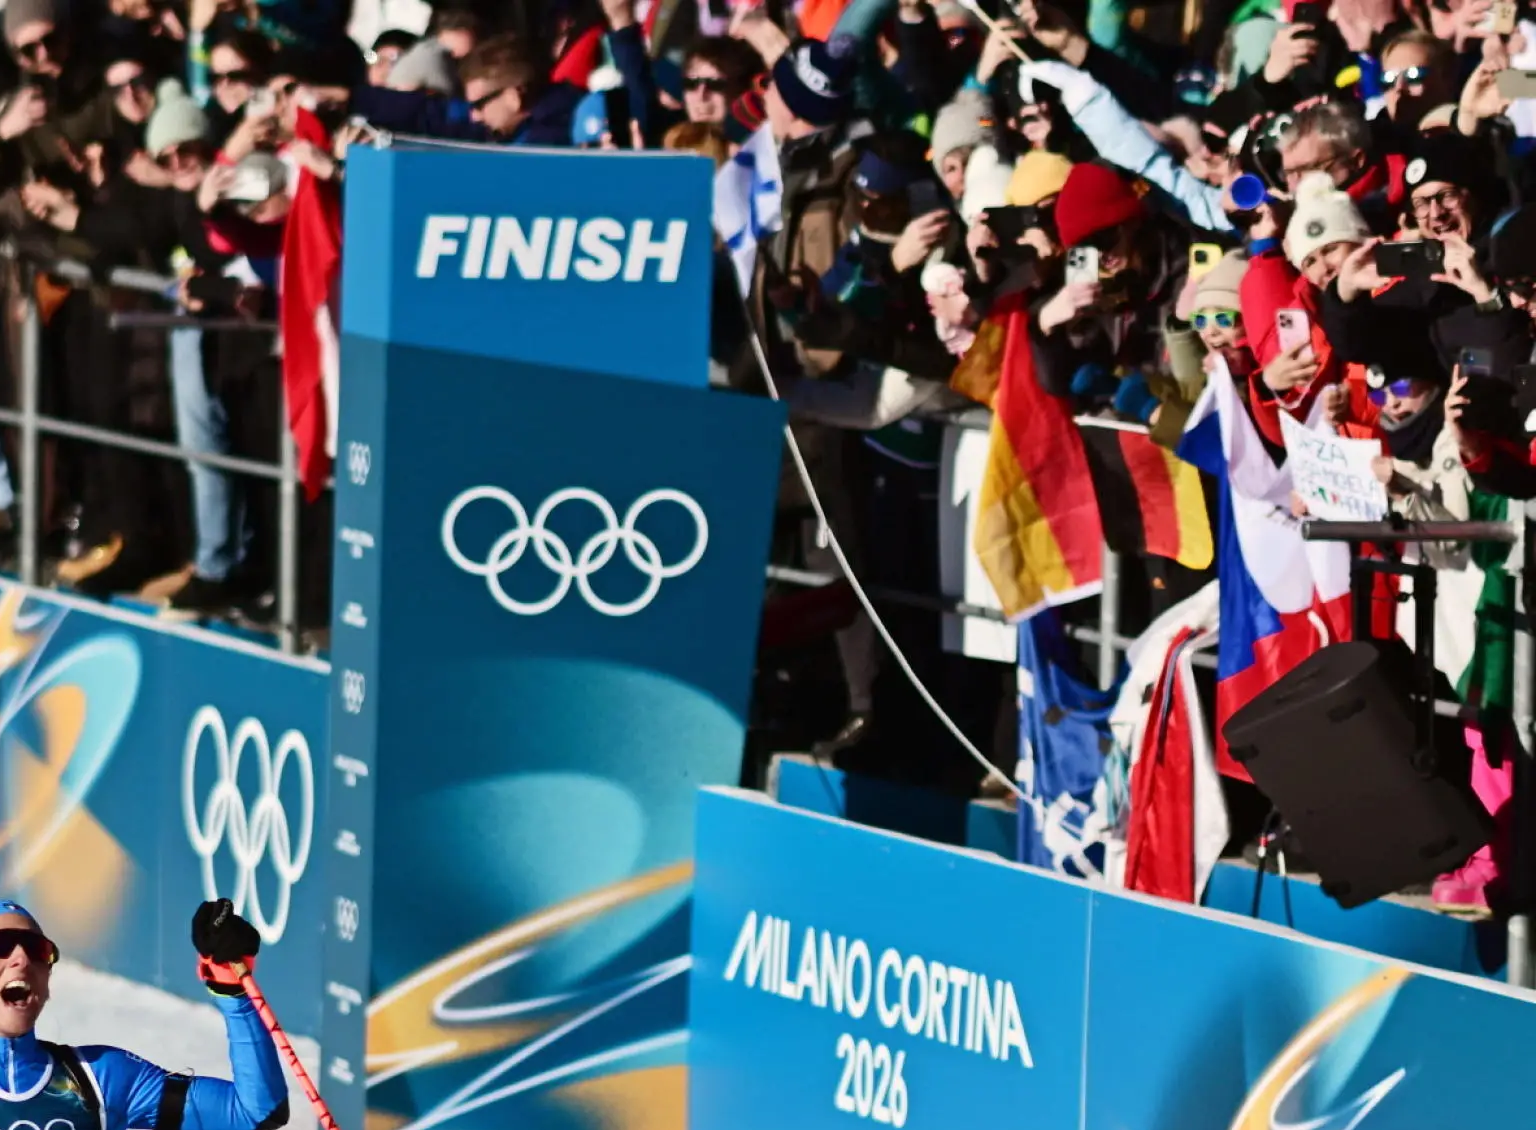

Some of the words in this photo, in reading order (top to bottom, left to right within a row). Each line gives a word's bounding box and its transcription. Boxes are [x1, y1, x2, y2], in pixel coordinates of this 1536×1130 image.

[416, 215, 687, 282] FINISH
[723, 910, 871, 1018] MILANO
[876, 948, 1033, 1068] CORTINA
[835, 1033, 908, 1128] 2026
